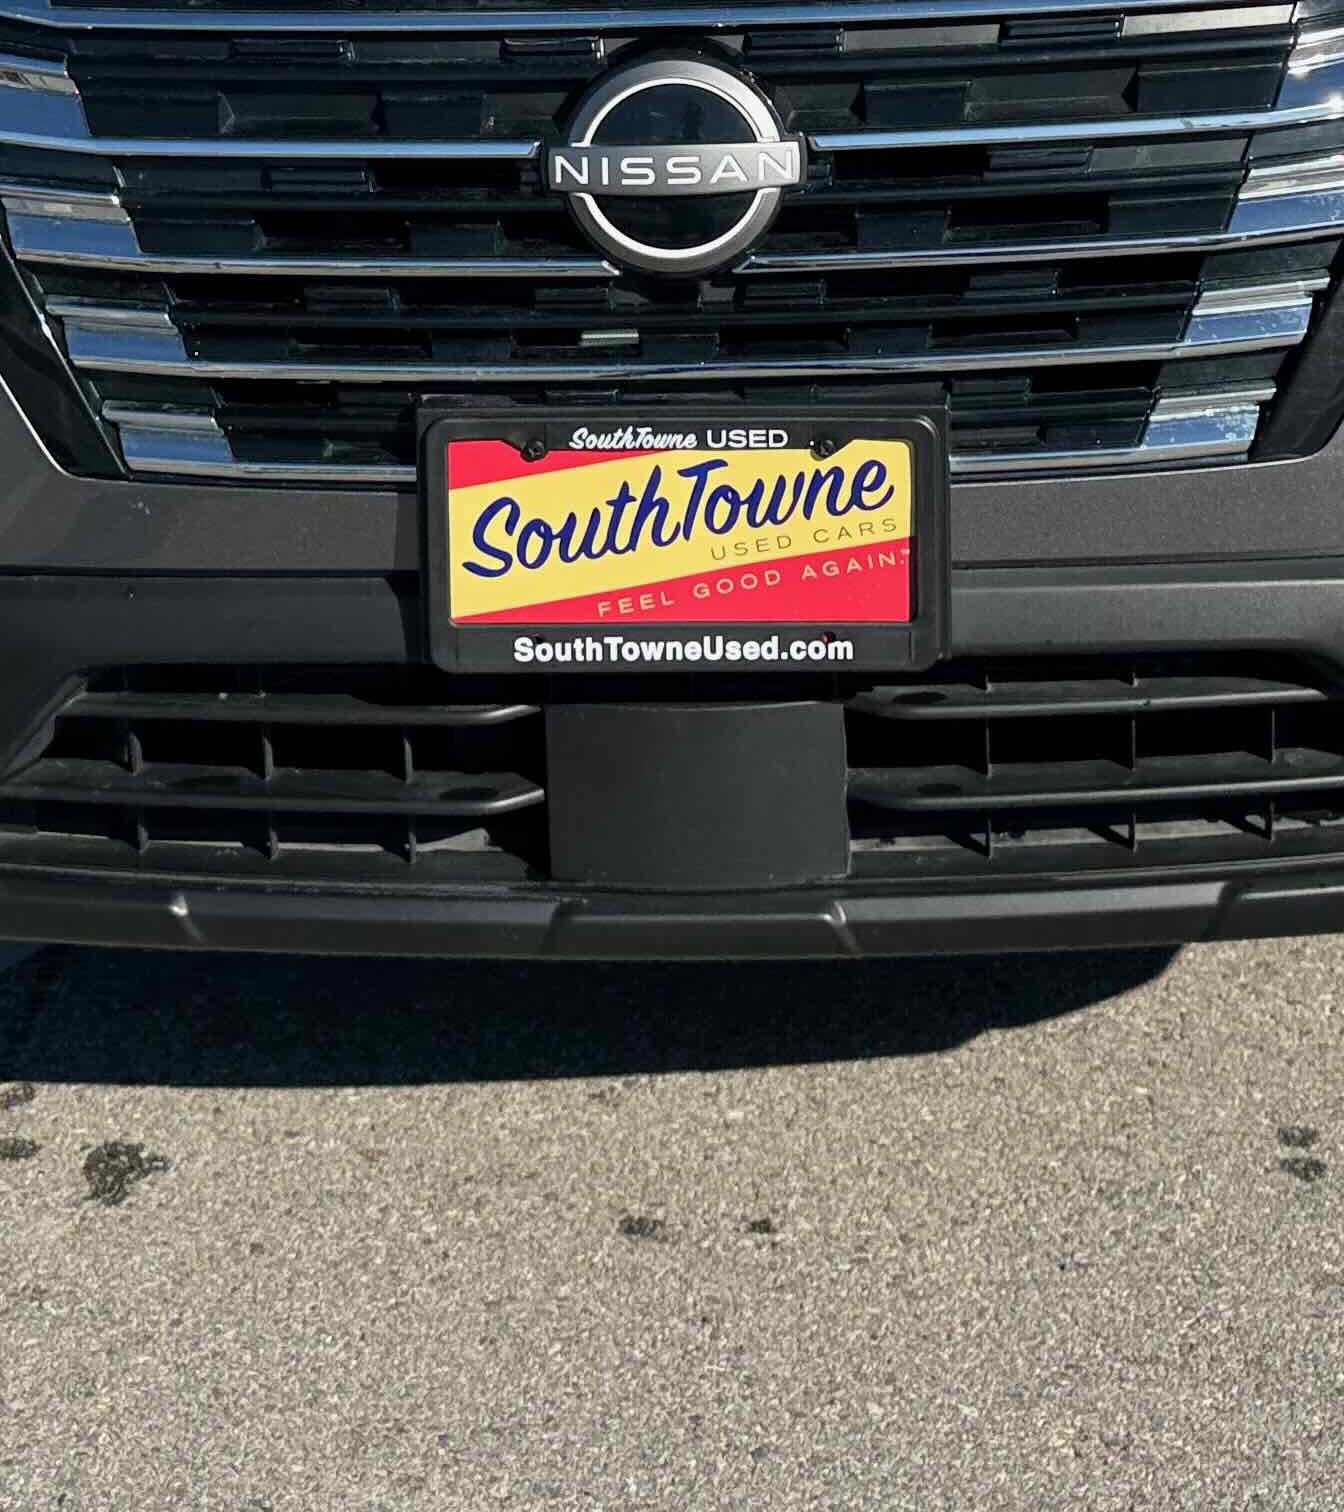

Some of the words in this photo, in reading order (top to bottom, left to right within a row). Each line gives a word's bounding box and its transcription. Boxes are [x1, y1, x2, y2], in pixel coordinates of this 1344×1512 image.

[554, 151, 794, 186] NISSAN
[568, 426, 698, 450] SouthTowne
[706, 429, 789, 449] USED
[461, 458, 896, 579] SouthTowne
[710, 534, 793, 562] USED
[812, 518, 897, 544] CARS
[597, 591, 675, 618] FEEL
[692, 569, 782, 600] GOOD
[512, 635, 855, 663] SouthTowneUsed.com
